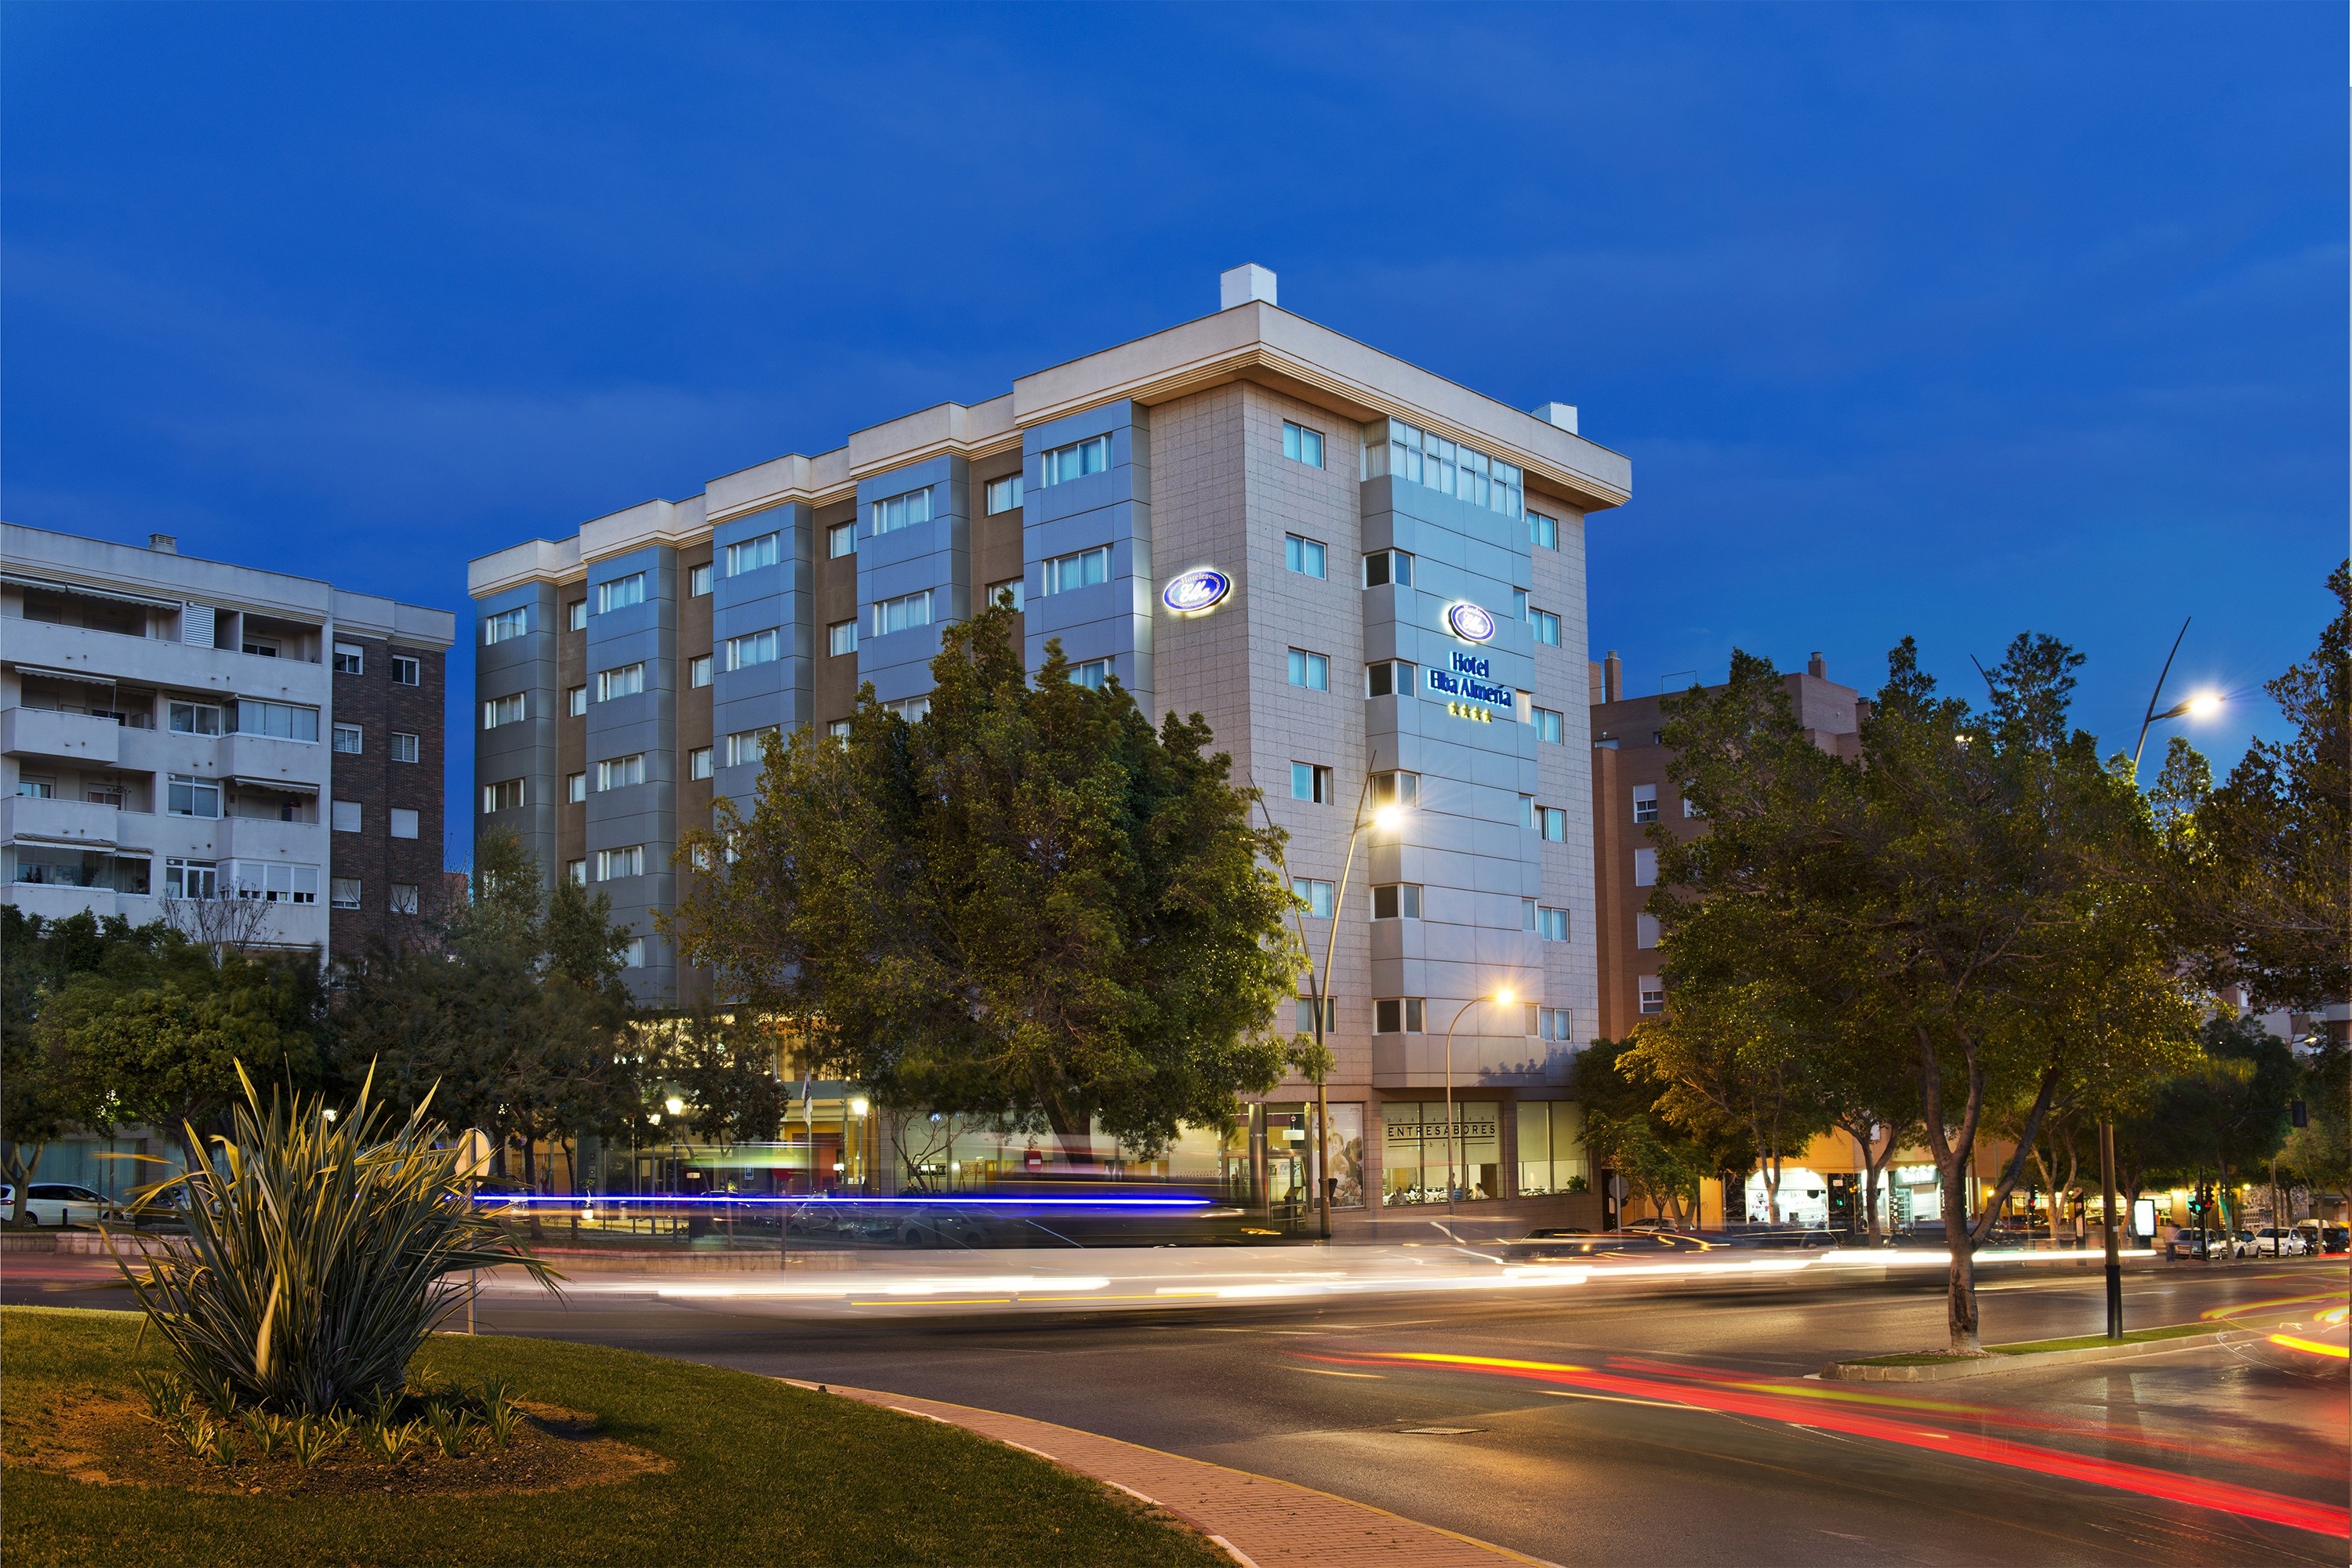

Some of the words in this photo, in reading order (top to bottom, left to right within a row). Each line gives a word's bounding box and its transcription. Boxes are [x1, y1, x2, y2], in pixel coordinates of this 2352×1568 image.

[1181, 572, 1209, 585] Hoteles
[1179, 580, 1210, 603] Elba
[1451, 651, 1489, 678] Hotel
[1429, 670, 1458, 695] Elba
[1460, 678, 1512, 707] Almería
[1388, 1124, 1495, 1137] ENTRESABORES
